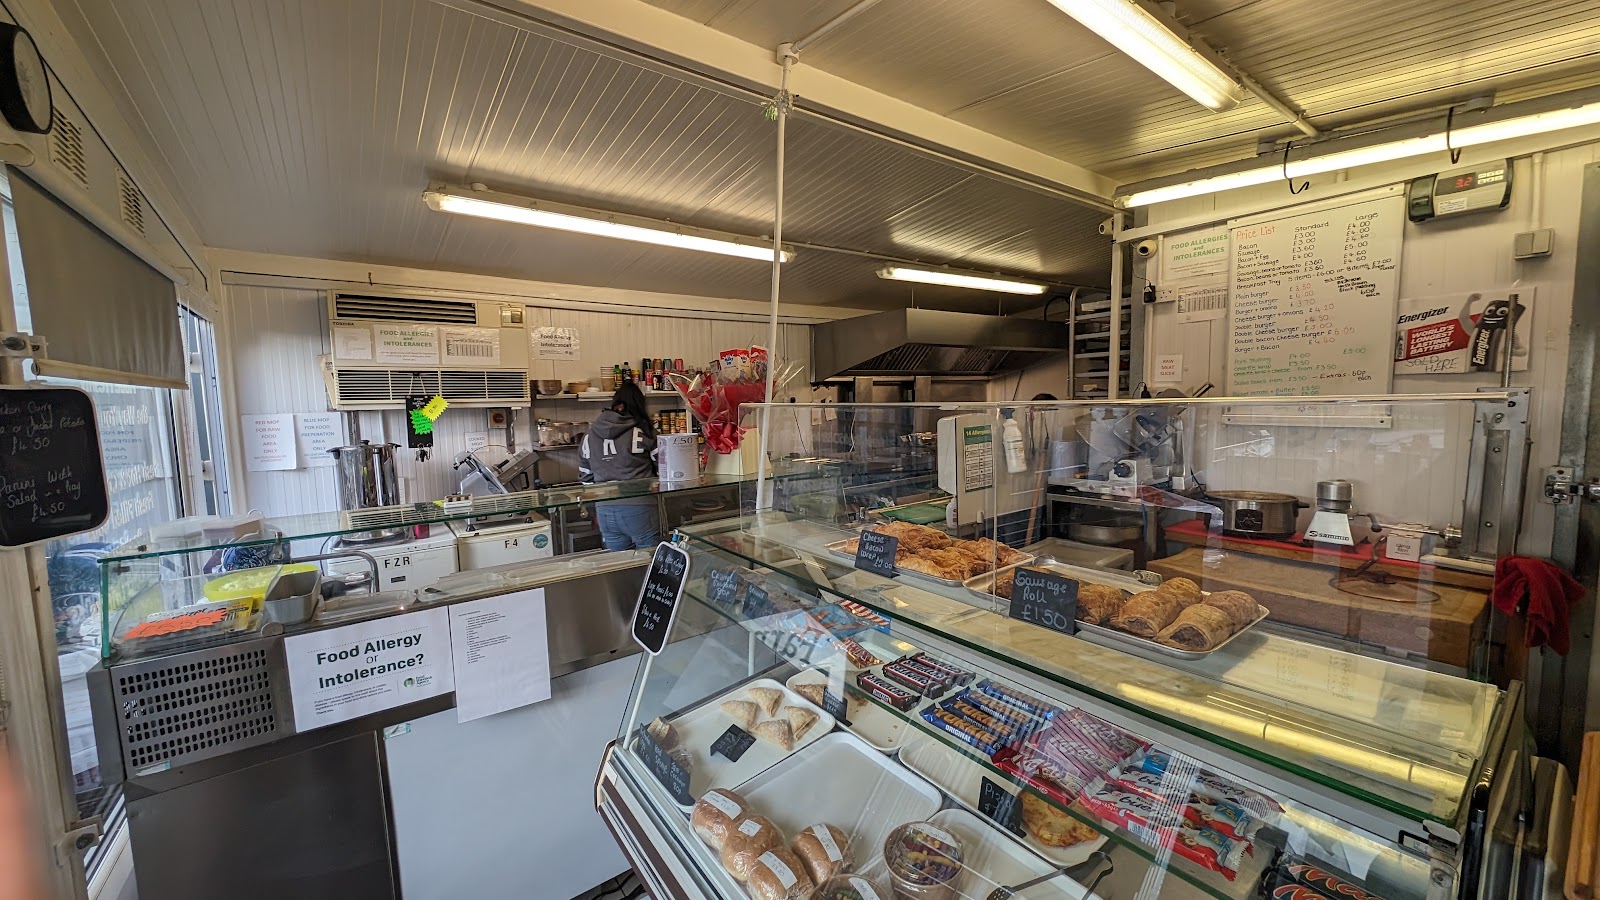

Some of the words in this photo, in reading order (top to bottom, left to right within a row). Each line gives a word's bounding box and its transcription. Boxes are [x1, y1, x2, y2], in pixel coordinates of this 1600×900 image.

[1355, 212, 1379, 221] Large
[1237, 229, 1257, 240] Price
[1260, 226, 1275, 235] List
[1295, 222, 1329, 232] Standard
[1171, 242, 1190, 250] FOOD
[1190, 234, 1228, 246] ALLERGIES
[1173, 247, 1225, 261] INTOLERANCES
[1237, 281, 1266, 290] Breakfast
[1250, 291, 1269, 299] burger
[1235, 308, 1253, 316] Burger
[1257, 313, 1276, 321] burger
[1397, 306, 1449, 324] Energizer
[1254, 321, 1276, 329] burger
[1277, 326, 1299, 334] burger
[1412, 324, 1455, 338] WORLD'S
[1301, 330, 1325, 338] burger
[1411, 330, 1455, 344] LONGEST
[1410, 337, 1450, 349] LASTING
[1410, 341, 1454, 354] BATTERY
[1473, 329, 1490, 365] Energizer
[1406, 356, 1439, 367] SOLD
[1425, 357, 1458, 372] HERE
[673, 437, 693, 445] £50
[7, 489, 37, 508] Salad
[863, 532, 884, 543] Cheese
[1015, 571, 1067, 596] Sausage
[1023, 586, 1047, 604] Roll
[317, 645, 360, 665] Food
[364, 633, 422, 655] Allergy
[366, 653, 379, 664] or
[319, 654, 424, 689] Intolerance?
[890, 664, 929, 685] SNICKERS
[902, 660, 945, 679] SNICKERS
[867, 674, 907, 697] SNICKERS
[1002, 694, 1029, 710] ORIGINAL
[953, 700, 1012, 735] YORKIE
[980, 705, 1007, 720] ORIGINAL
[933, 708, 998, 744] YORKIE
[963, 715, 989, 730] ORIGINAL
[945, 724, 972, 743] ORIGINAL
